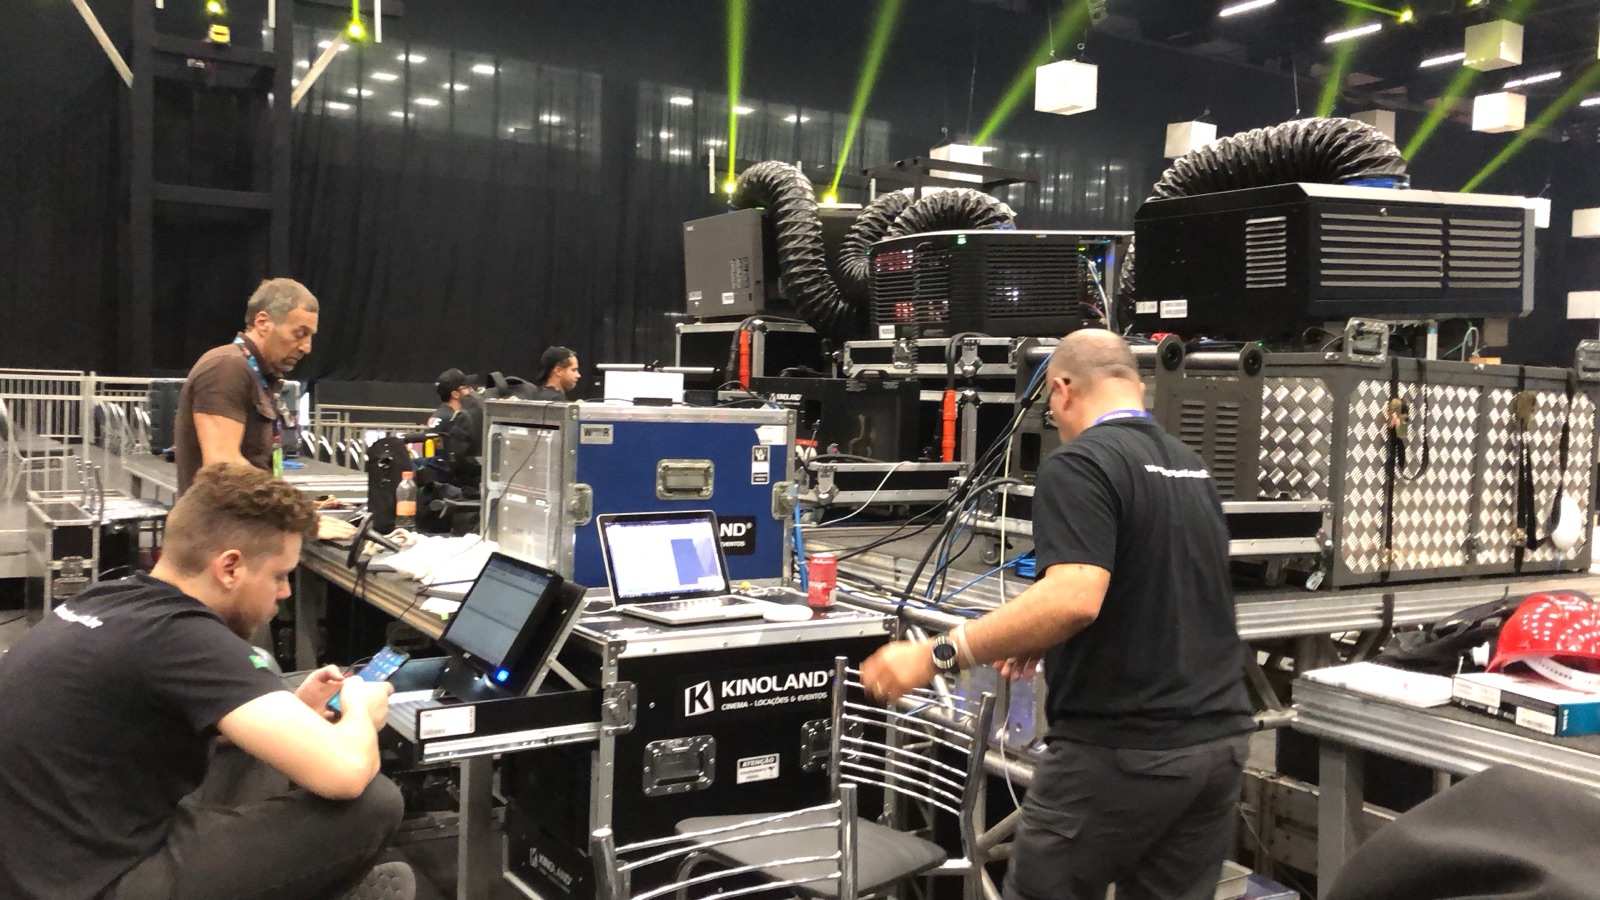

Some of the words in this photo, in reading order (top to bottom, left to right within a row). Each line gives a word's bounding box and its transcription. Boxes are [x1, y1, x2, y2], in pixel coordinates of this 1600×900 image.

[721, 670, 829, 698] KINOLAND
[720, 701, 749, 711] CINEMA
[797, 691, 828, 702] EVENTOS
